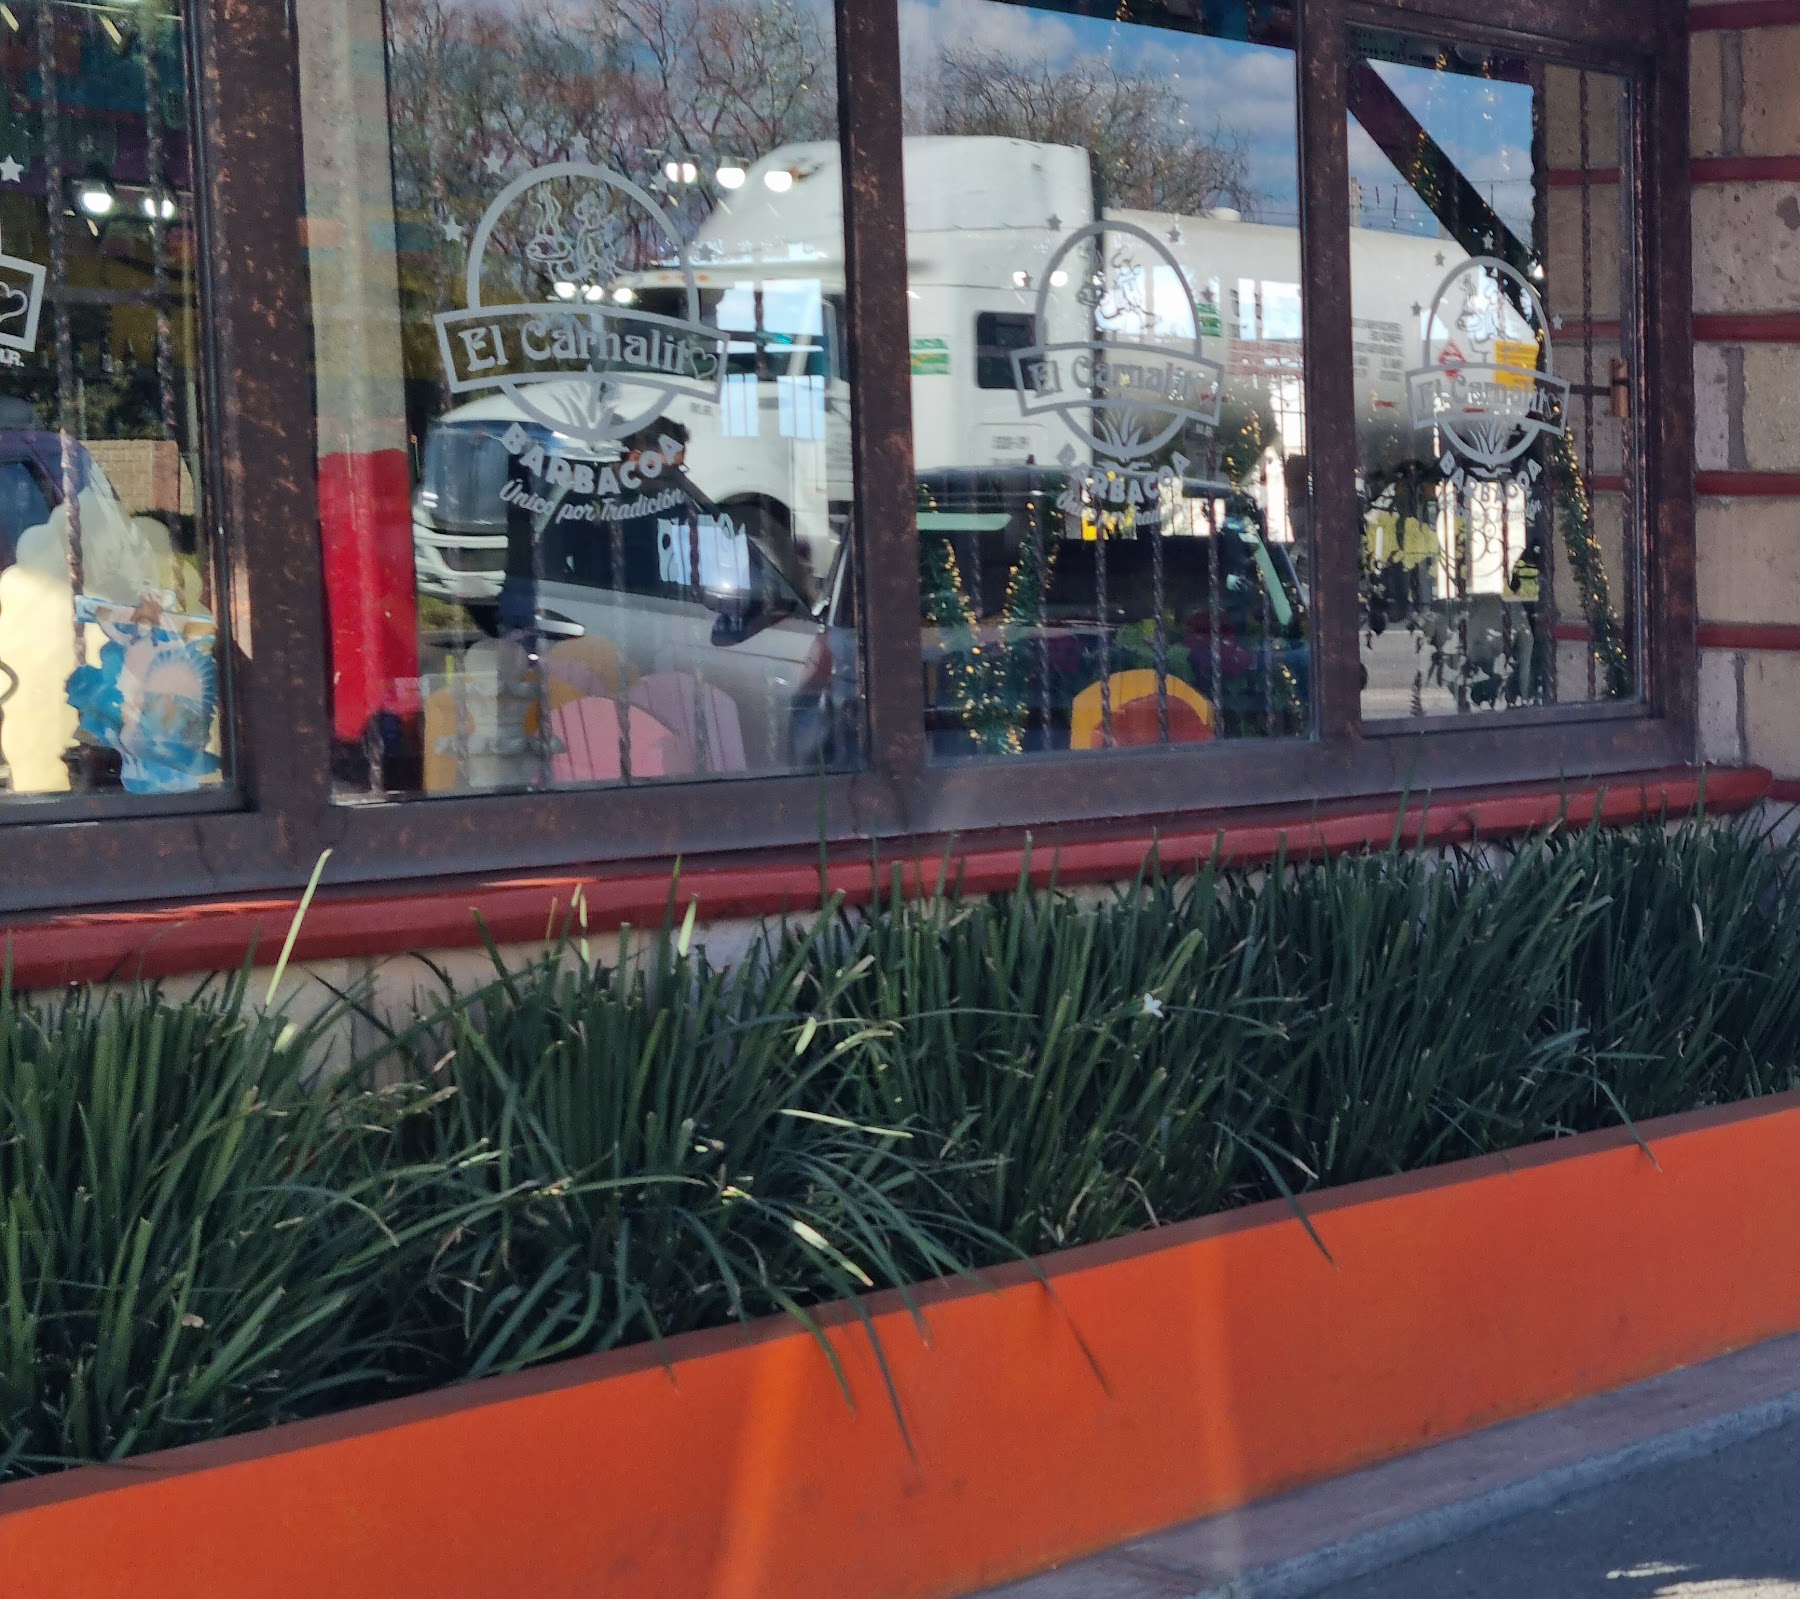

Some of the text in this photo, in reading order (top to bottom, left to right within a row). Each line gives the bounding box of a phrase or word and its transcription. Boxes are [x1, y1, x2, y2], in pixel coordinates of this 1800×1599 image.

[459, 324, 509, 372] El
[502, 422, 684, 496] BARBACOA
[500, 478, 687, 525] Único por Tradición
